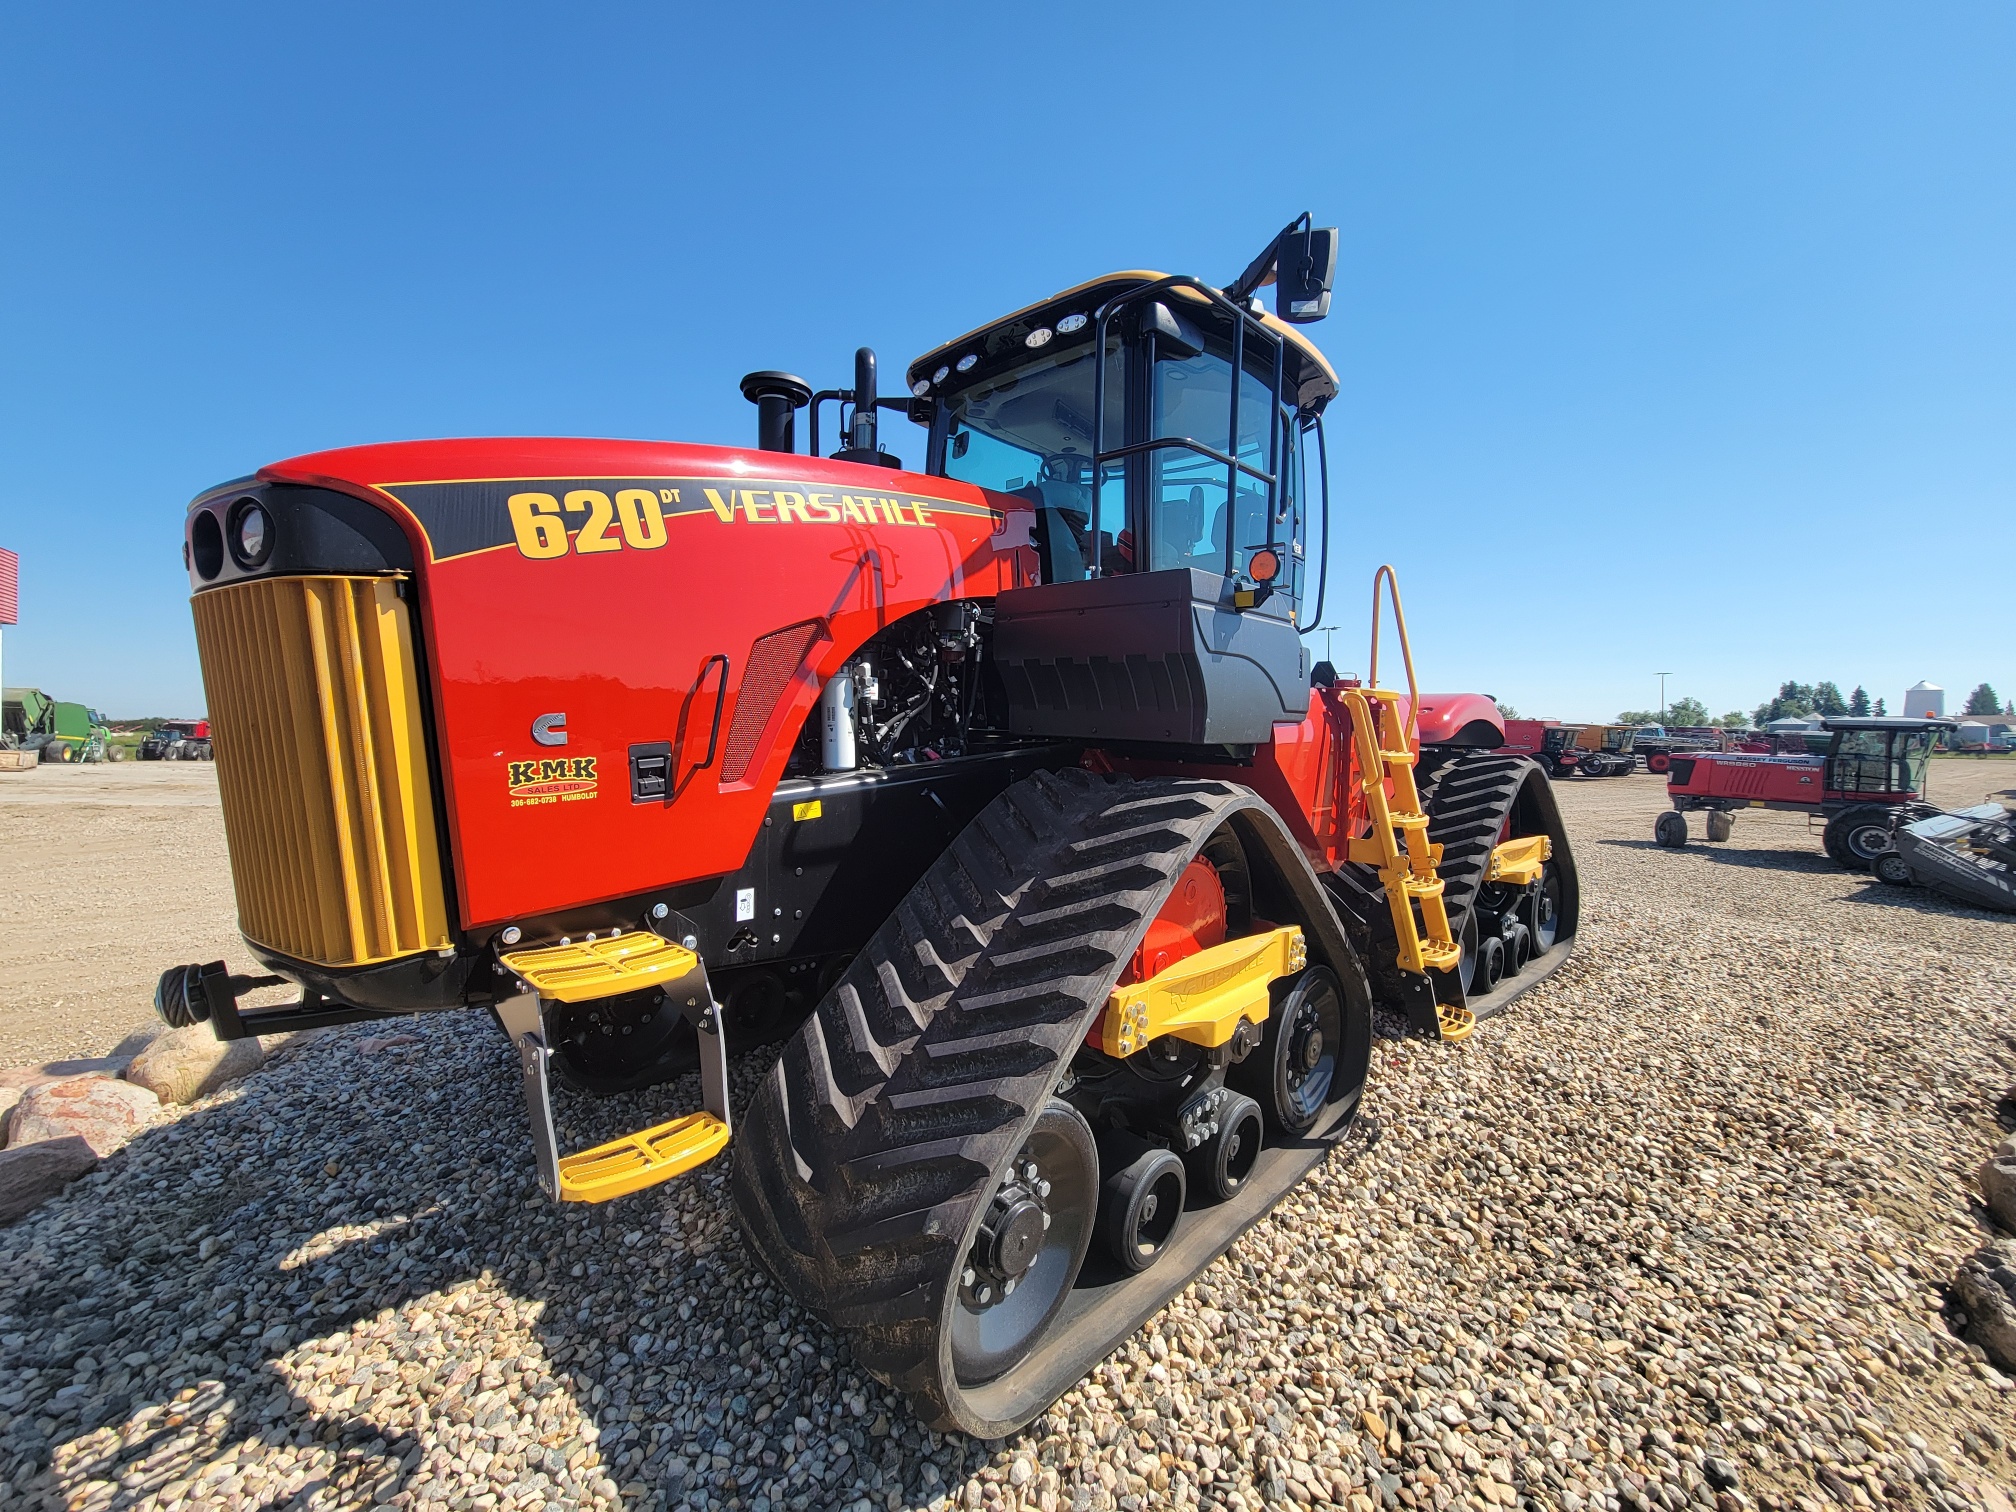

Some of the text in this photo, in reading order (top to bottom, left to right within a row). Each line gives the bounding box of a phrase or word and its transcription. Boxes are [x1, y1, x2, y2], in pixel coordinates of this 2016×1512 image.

[702, 488, 937, 528] VERSATILE
[508, 488, 681, 560] 620 DT
[1768, 757, 1810, 765] FERGUSON
[1786, 765, 1820, 773] HESSTON
[527, 785, 560, 795] SALES
[510, 791, 598, 808] 306-682-0738 HUMBOLDT
[1923, 844, 1953, 861] MASSEY
[1951, 858, 1989, 879] FERGUSON
